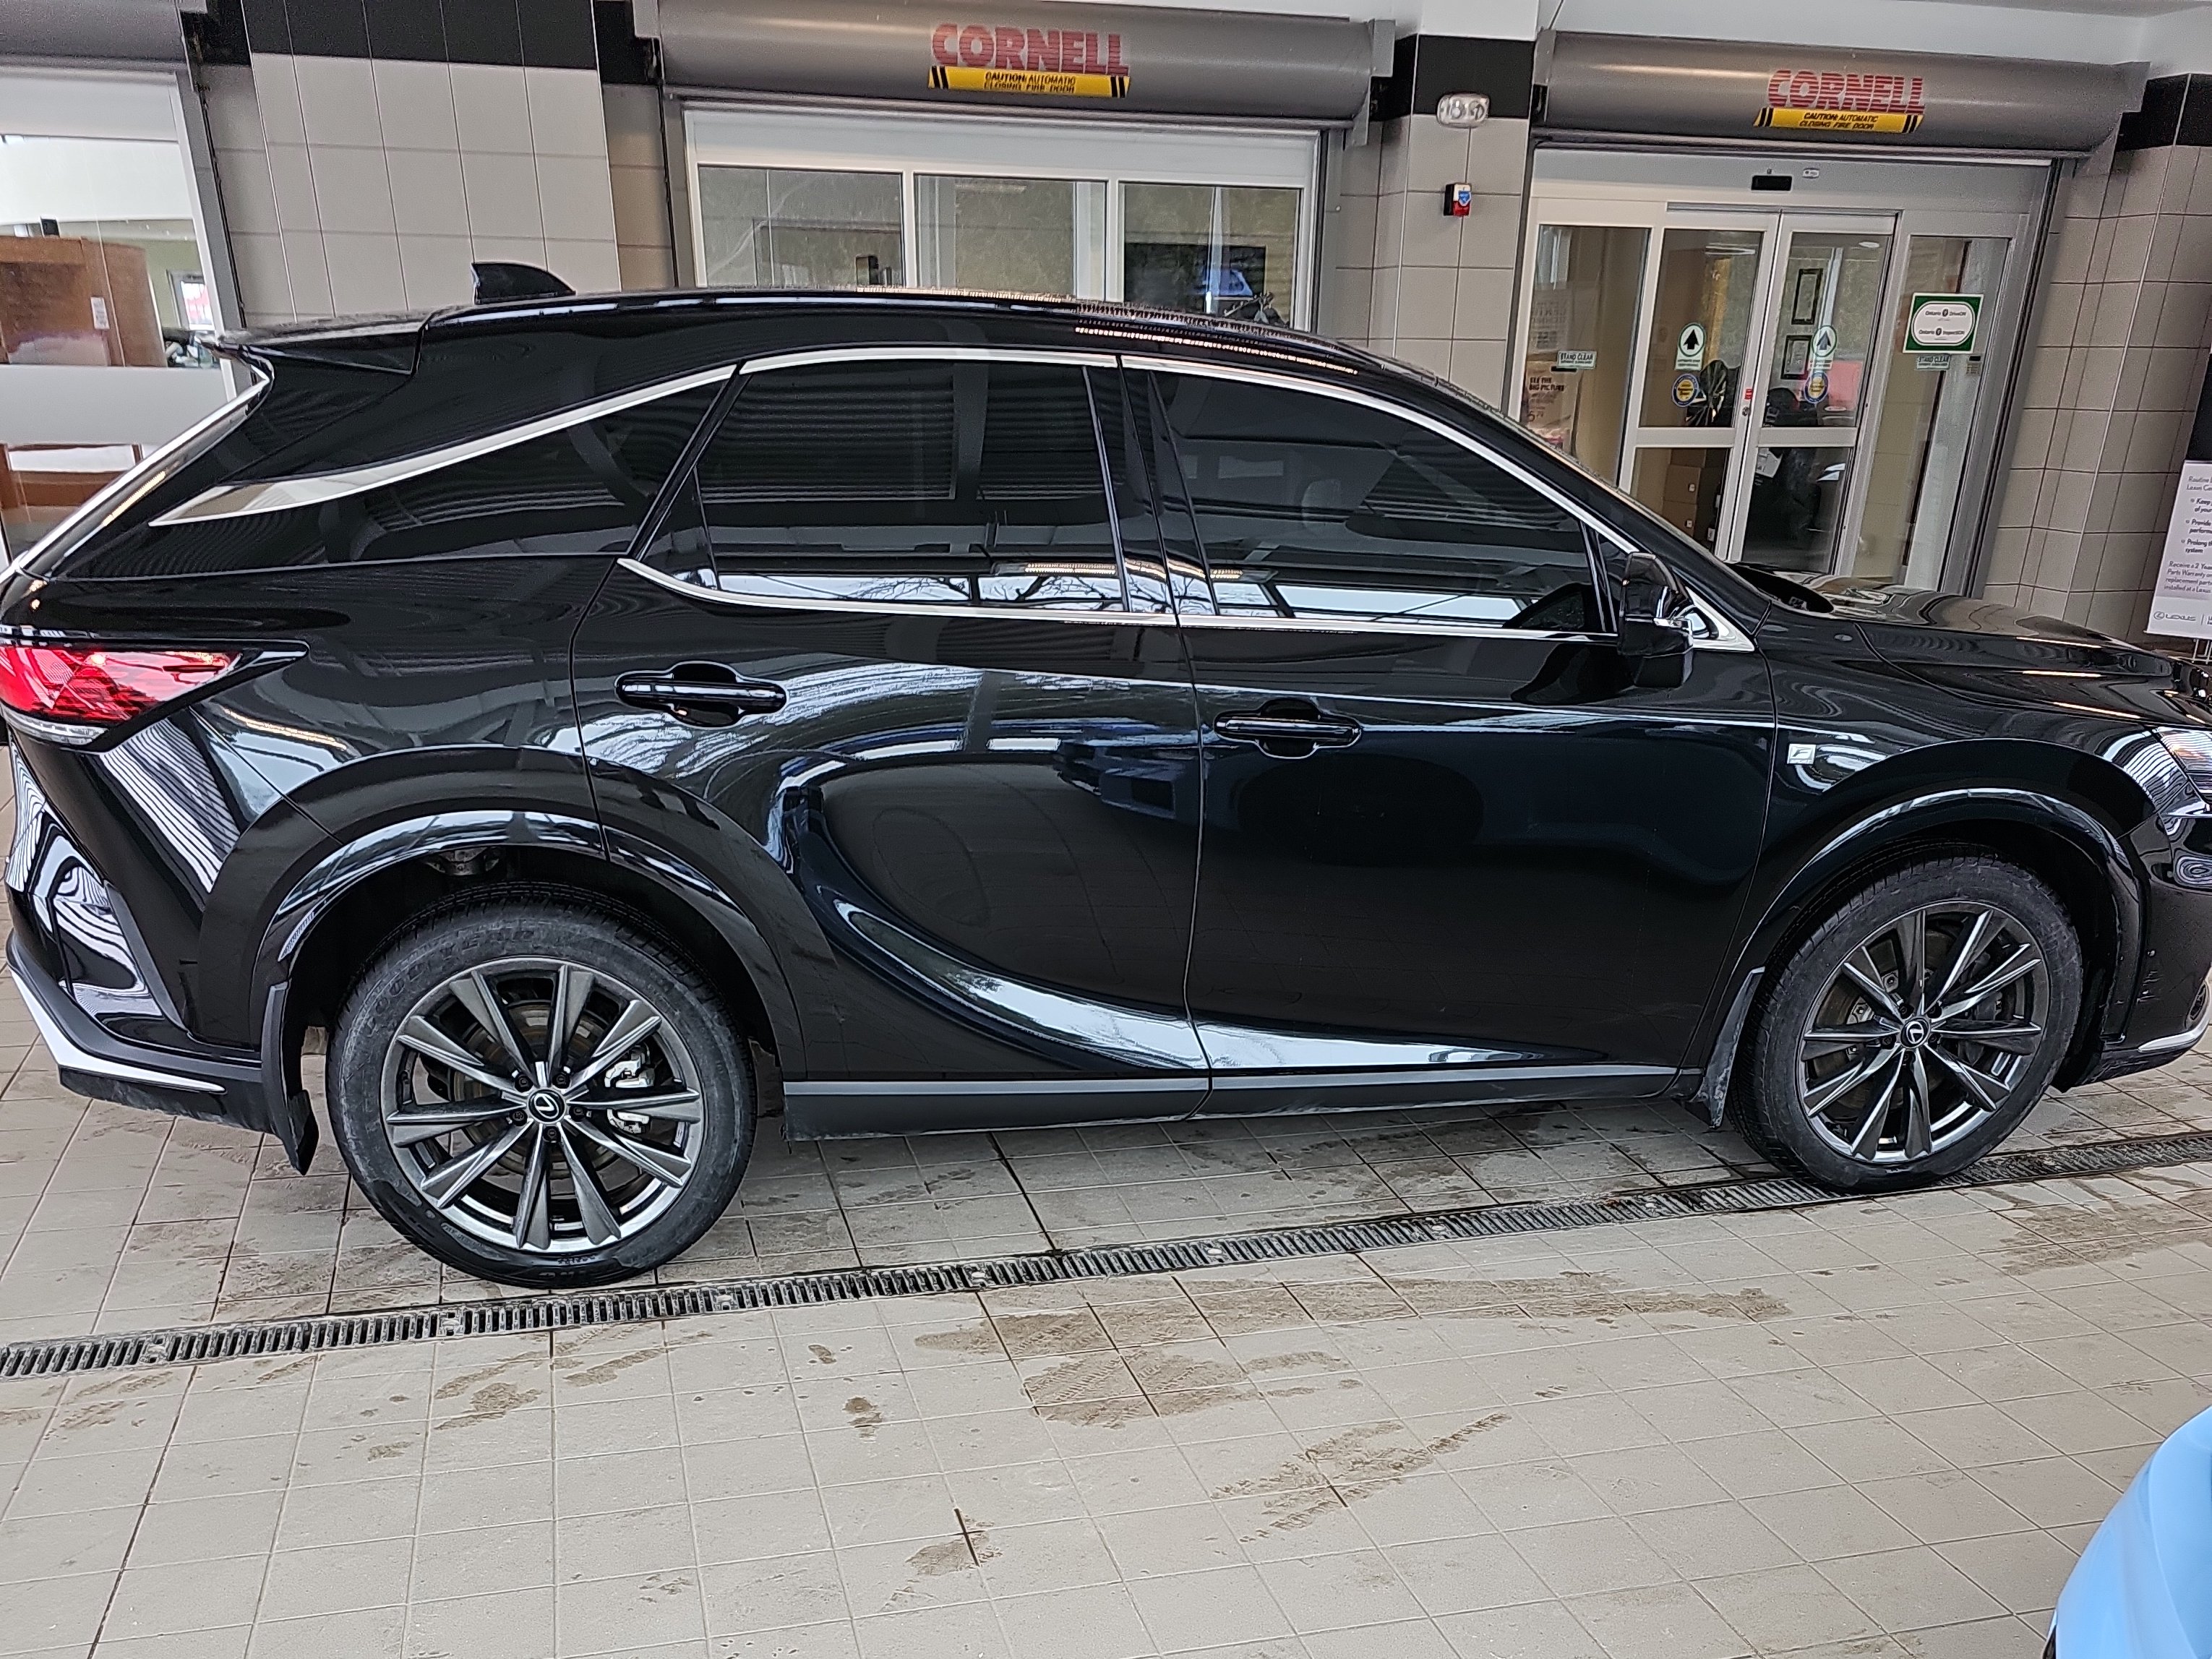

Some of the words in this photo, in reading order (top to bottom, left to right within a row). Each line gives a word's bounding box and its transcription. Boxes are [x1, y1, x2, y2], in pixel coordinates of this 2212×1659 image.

[932, 23, 1129, 77] CORNELL
[1028, 74, 1076, 86] AUTOMATIC
[1767, 69, 1925, 114] CORNELL
[1560, 352, 1576, 361] STAND
[1577, 352, 1593, 361] CLEAR
